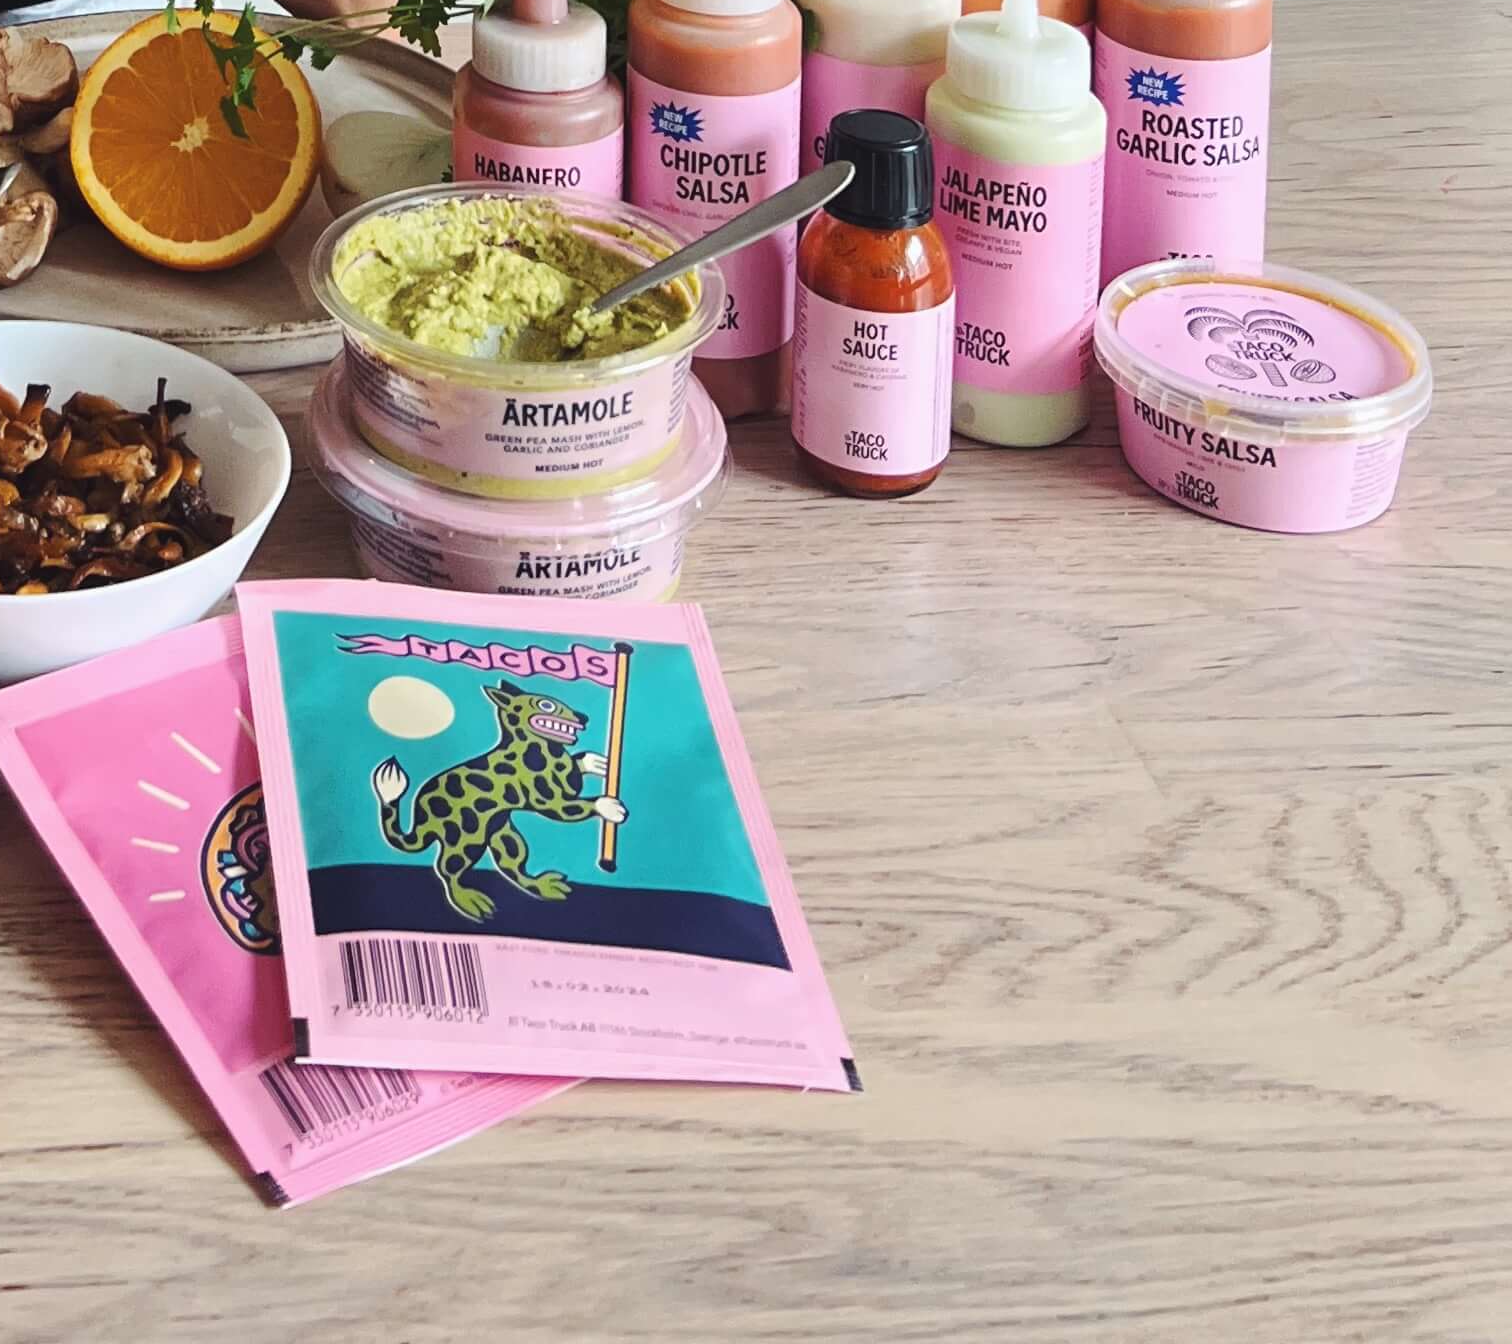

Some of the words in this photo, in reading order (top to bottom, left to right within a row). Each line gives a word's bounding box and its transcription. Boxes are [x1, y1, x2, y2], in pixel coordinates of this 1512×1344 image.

[1137, 84, 1169, 100] RECIPE
[1142, 76, 1164, 89] NEW
[659, 118, 688, 136] RECIPE
[663, 110, 684, 124] NEW
[1142, 110, 1243, 140] ROASTED
[1116, 128, 1197, 166] GARLIC
[1203, 136, 1261, 167] SALSA
[474, 152, 581, 188] HABANERO
[660, 143, 767, 177] CHIPOTLE
[675, 175, 750, 204] SALSA
[942, 166, 1047, 208] JALAPEÑO
[939, 188, 981, 223] LIME
[986, 206, 1047, 233] MAYO
[995, 262, 1013, 270] HOT
[854, 320, 888, 341] HOT
[963, 322, 1006, 348] TACO
[842, 338, 898, 361] SAUCE
[956, 337, 1011, 366] TRUCK
[1233, 350, 1297, 362] TRUCK
[1237, 340, 1284, 352] TACO
[502, 391, 634, 427] ÄRTAMOLE
[485, 432, 522, 444] GREEN
[526, 436, 547, 445] PEA
[551, 435, 582, 444] MASH
[585, 429, 610, 441] WITH
[503, 444, 544, 454] GARLIC
[547, 445, 571, 454] AND
[574, 434, 631, 452] CORIANDER
[851, 430, 885, 447] TACO
[1134, 398, 1196, 446] FRUITY
[1201, 433, 1277, 468] SALSA
[845, 442, 888, 461] TRUCK
[535, 462, 579, 472] MEDIUM
[583, 458, 604, 470] HOT
[1180, 470, 1216, 494] TACO
[1176, 481, 1219, 509] TRUCK
[516, 546, 641, 579] ÄRTAMOLE
[539, 588, 560, 596] PEA
[563, 585, 593, 595] MASH
[597, 579, 620, 589] WITH
[418, 641, 608, 676] TACOS
